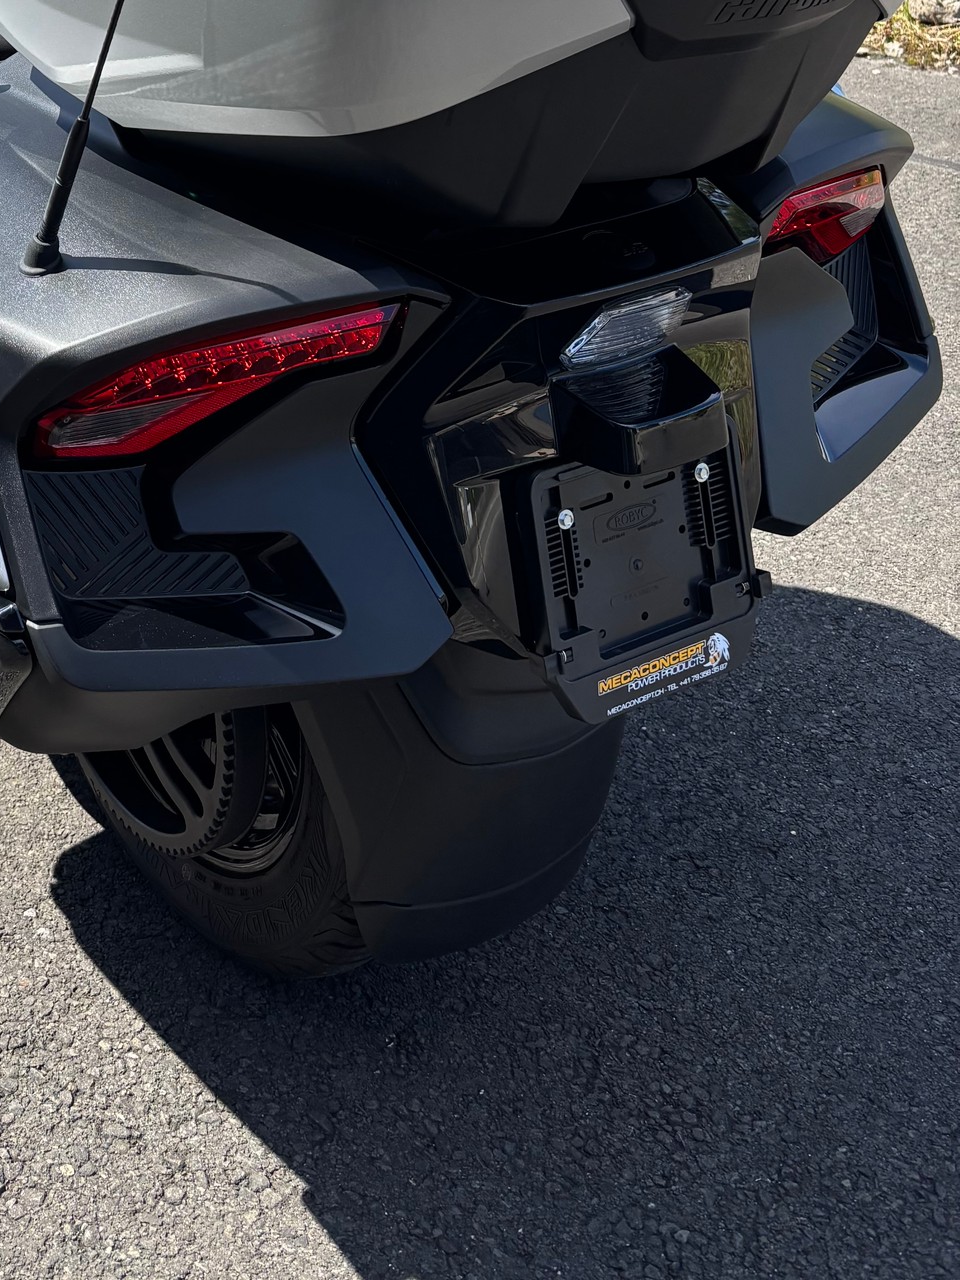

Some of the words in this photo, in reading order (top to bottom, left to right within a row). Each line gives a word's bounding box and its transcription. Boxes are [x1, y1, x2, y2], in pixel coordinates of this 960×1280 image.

[613, 505, 649, 528] ROBYC
[597, 639, 707, 697] MECACONCEPT
[627, 671, 661, 692] POWER
[660, 654, 706, 681] PRODUCTS
[606, 687, 665, 716] MECACONCEPT.CH
[679, 677, 691, 686] +41
[691, 673, 700, 682] 79
